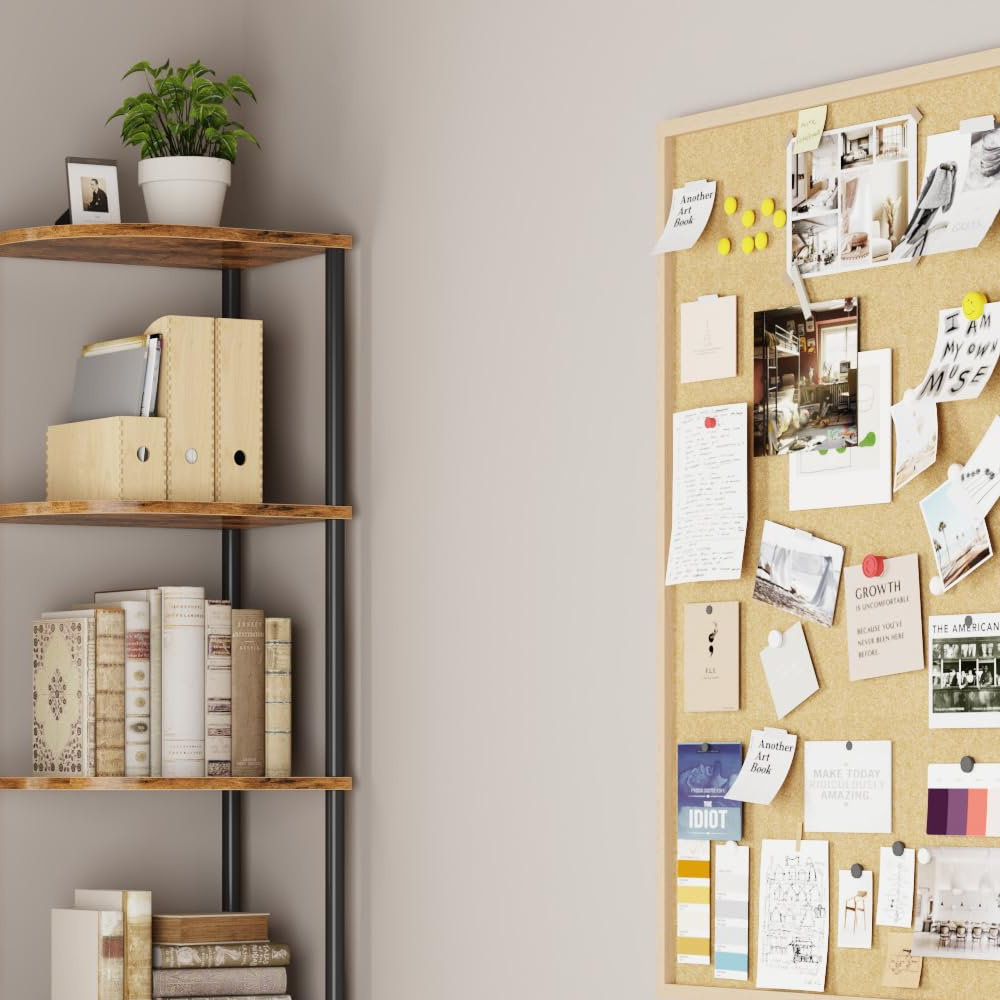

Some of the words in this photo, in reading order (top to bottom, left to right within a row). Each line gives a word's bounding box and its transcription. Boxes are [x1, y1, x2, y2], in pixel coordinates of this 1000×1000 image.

[680, 192, 713, 204] Another
[678, 206, 692, 216] Art
[673, 216, 694, 227] Book
[945, 312, 960, 333] I
[966, 313, 991, 335] AM
[941, 341, 963, 362] MY
[967, 338, 999, 358] OWN
[920, 364, 988, 395] MUSE
[855, 580, 901, 600] GROWTH
[862, 595, 910, 611] UNCOMFORTABLE
[857, 625, 881, 635] BECAUSE
[932, 624, 949, 633] THE
[952, 622, 1000, 633] AMERICAN
[857, 637, 875, 646] NEVER
[876, 635, 890, 643] BEEN
[891, 632, 905, 640] HERE
[759, 739, 793, 752] Another
[756, 752, 770, 762] Art
[750, 762, 772, 774] Book
[813, 768, 841, 778] MAKE
[847, 768, 881, 778] TODAY
[688, 809, 728, 830] IDIOT
